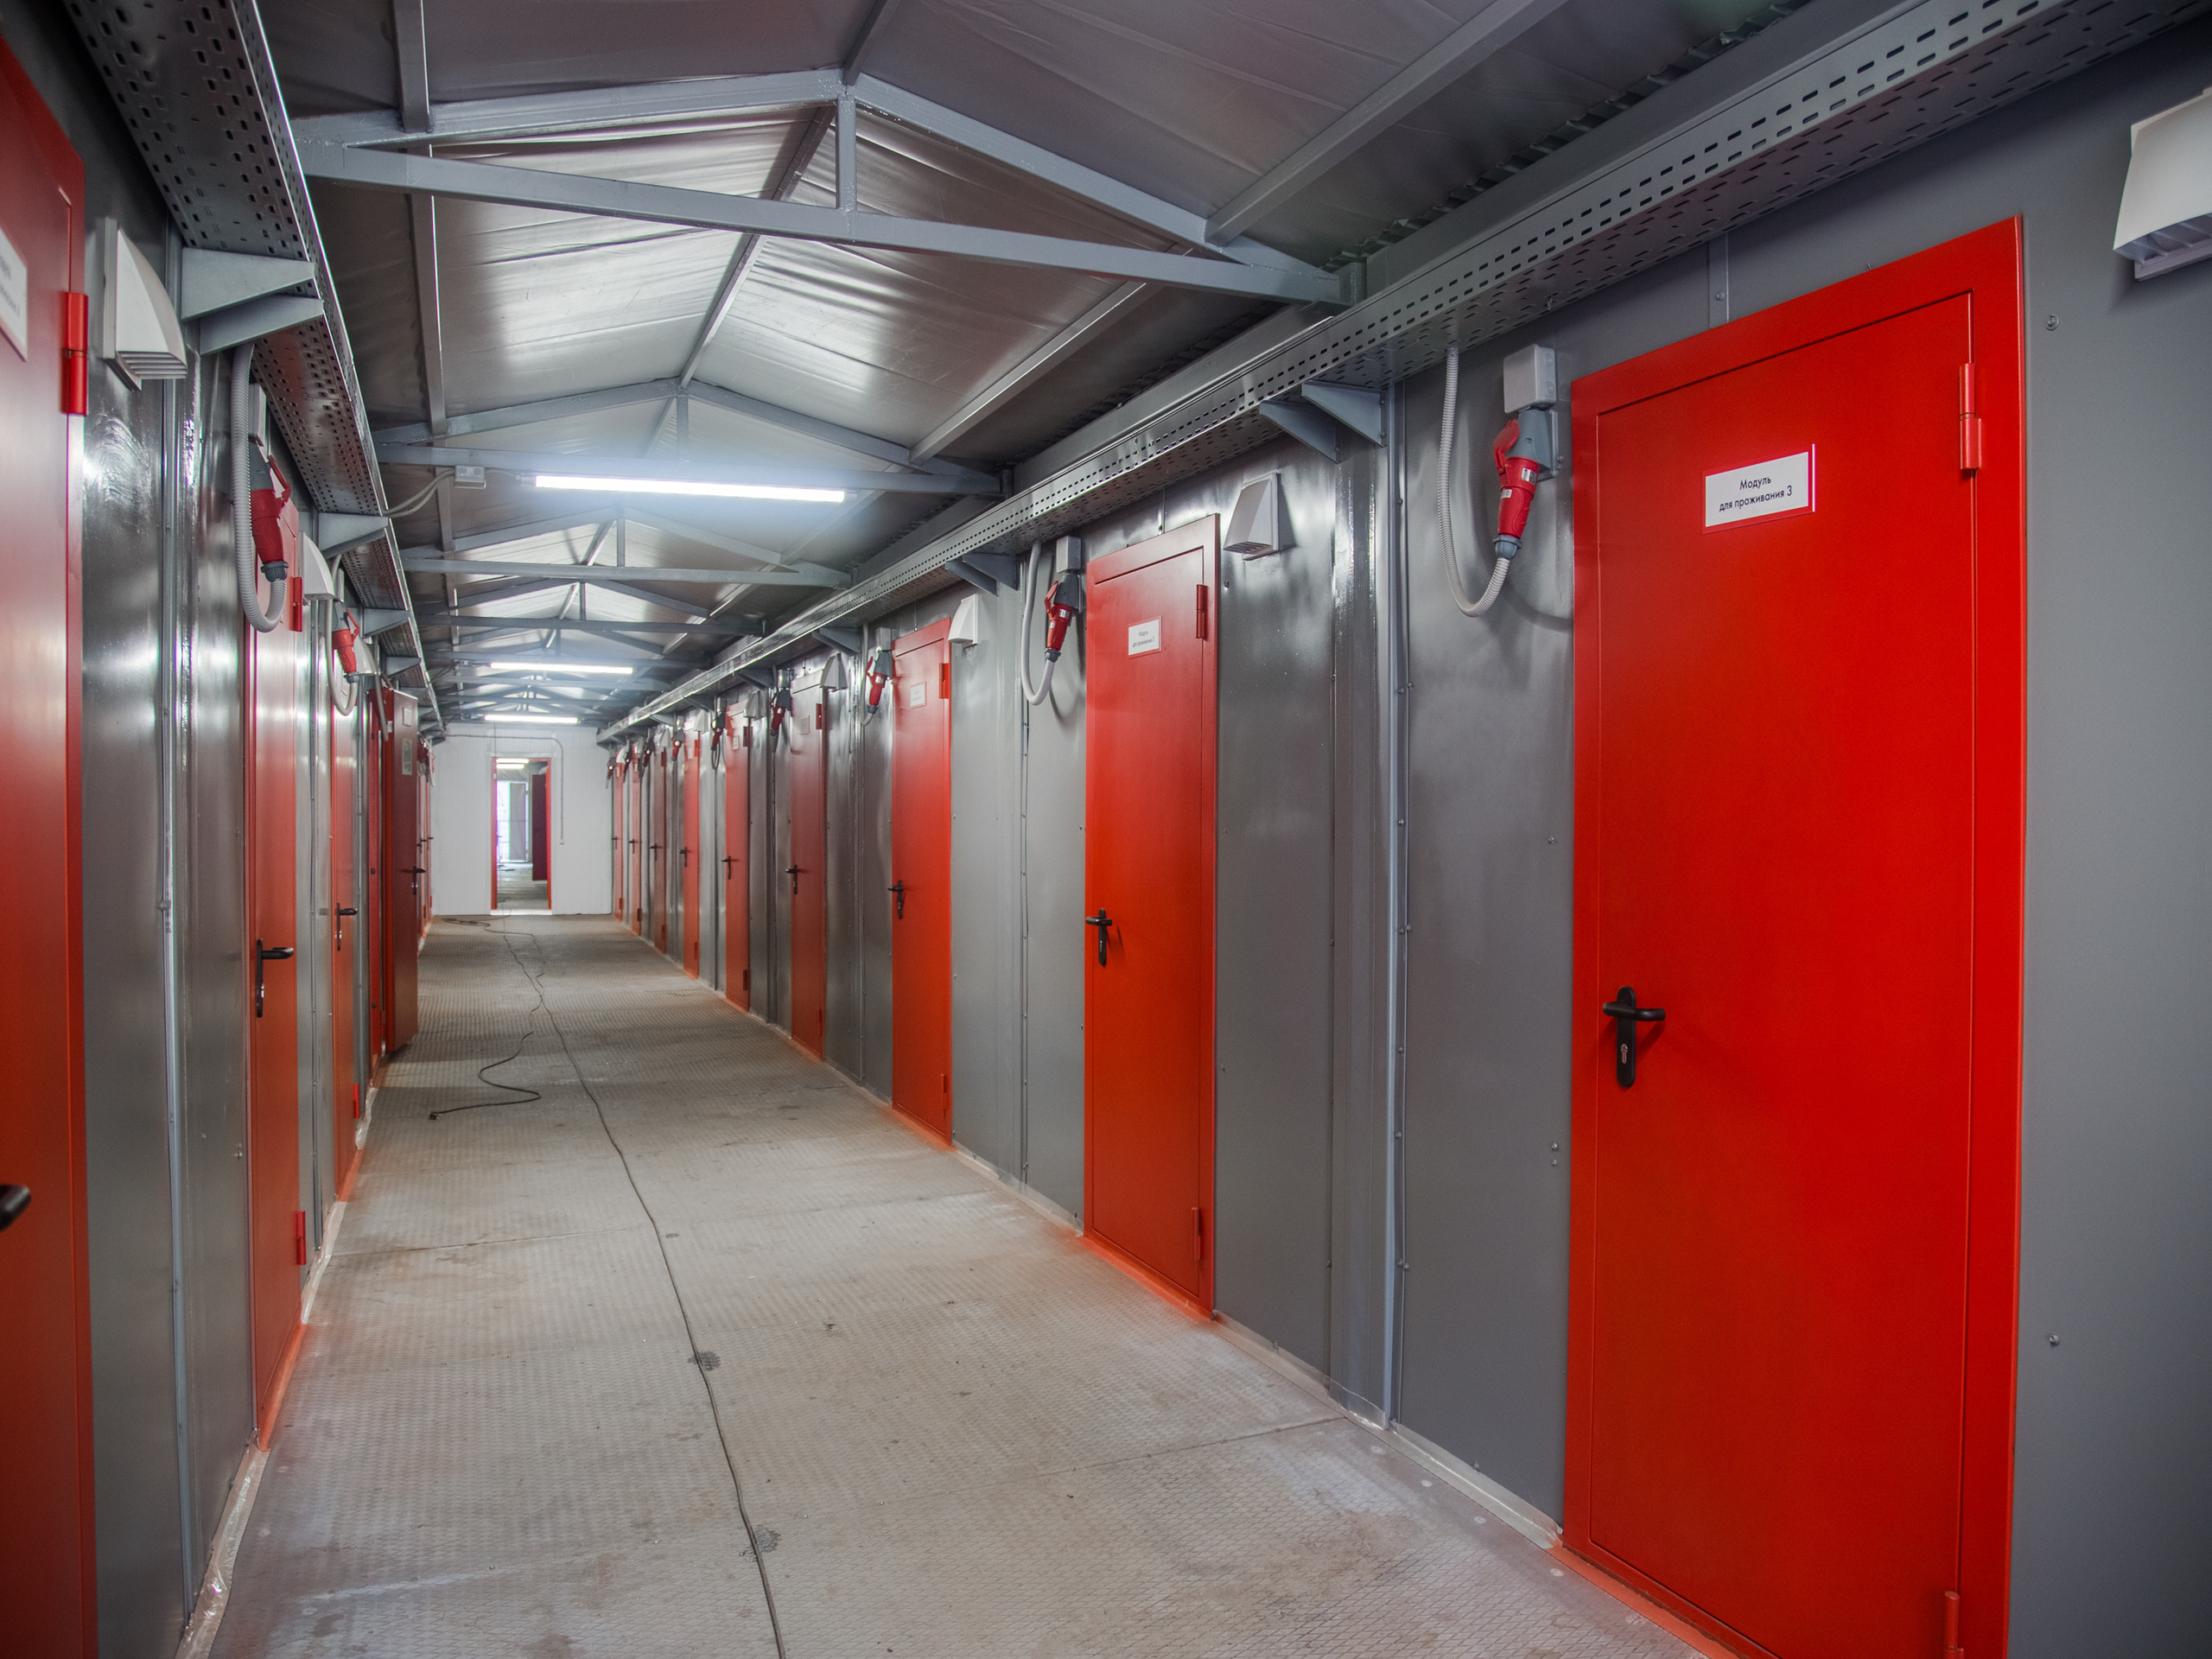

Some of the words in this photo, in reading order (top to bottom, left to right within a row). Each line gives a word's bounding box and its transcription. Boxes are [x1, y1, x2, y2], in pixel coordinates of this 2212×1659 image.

[1739, 476, 1771, 491] Модуль
[1719, 501, 1732, 512] для
[1734, 489, 1784, 510] проживания
[1786, 485, 1793, 497] 3
